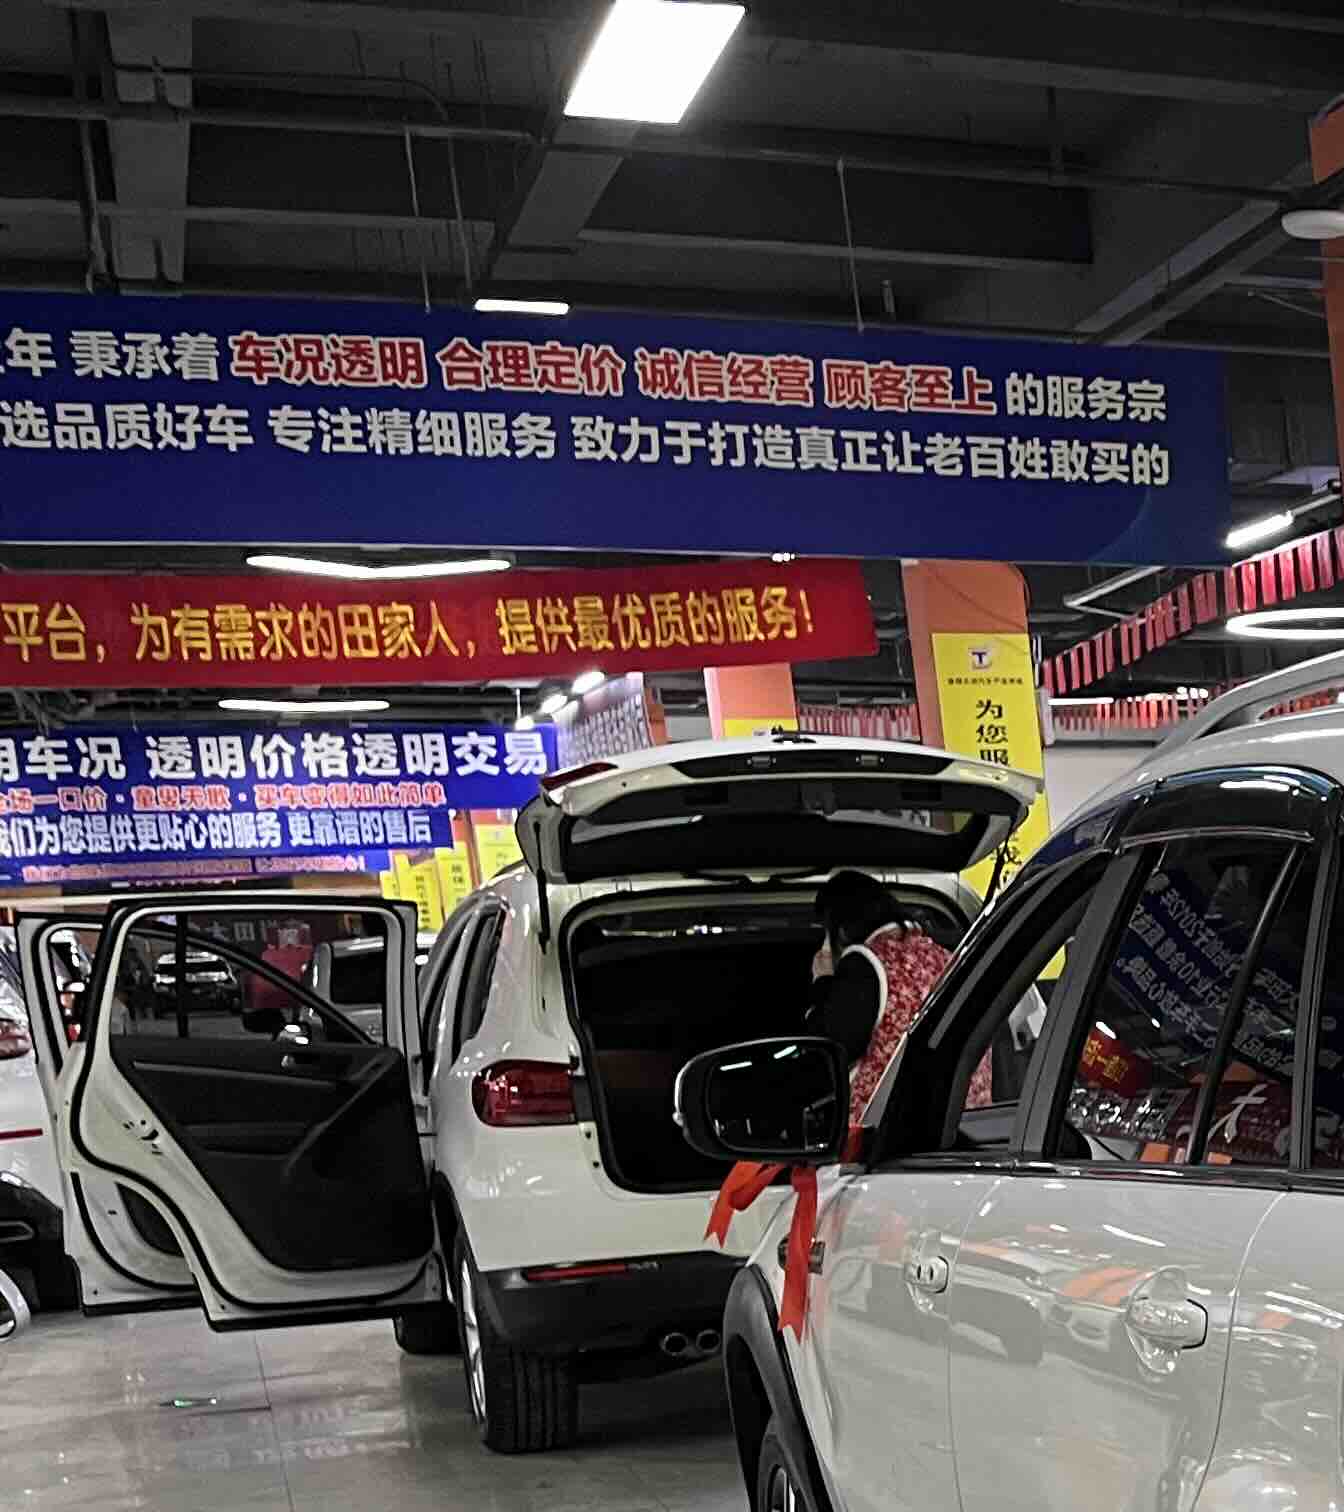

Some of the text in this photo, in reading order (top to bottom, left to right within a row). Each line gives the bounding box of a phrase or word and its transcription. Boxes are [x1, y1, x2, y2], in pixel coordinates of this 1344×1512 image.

[0, 329, 1168, 422] 年 秉承着 车况透明 合理定价 诚信经营 顾客至上 的服务宗
[0, 400, 1170, 486] 选品质好车 专注精细服务 致力于打造真正让老百姓敢买的
[146, 731, 548, 780] 透明价格透明交易
[288, 808, 432, 848] 更靠谱的售后
